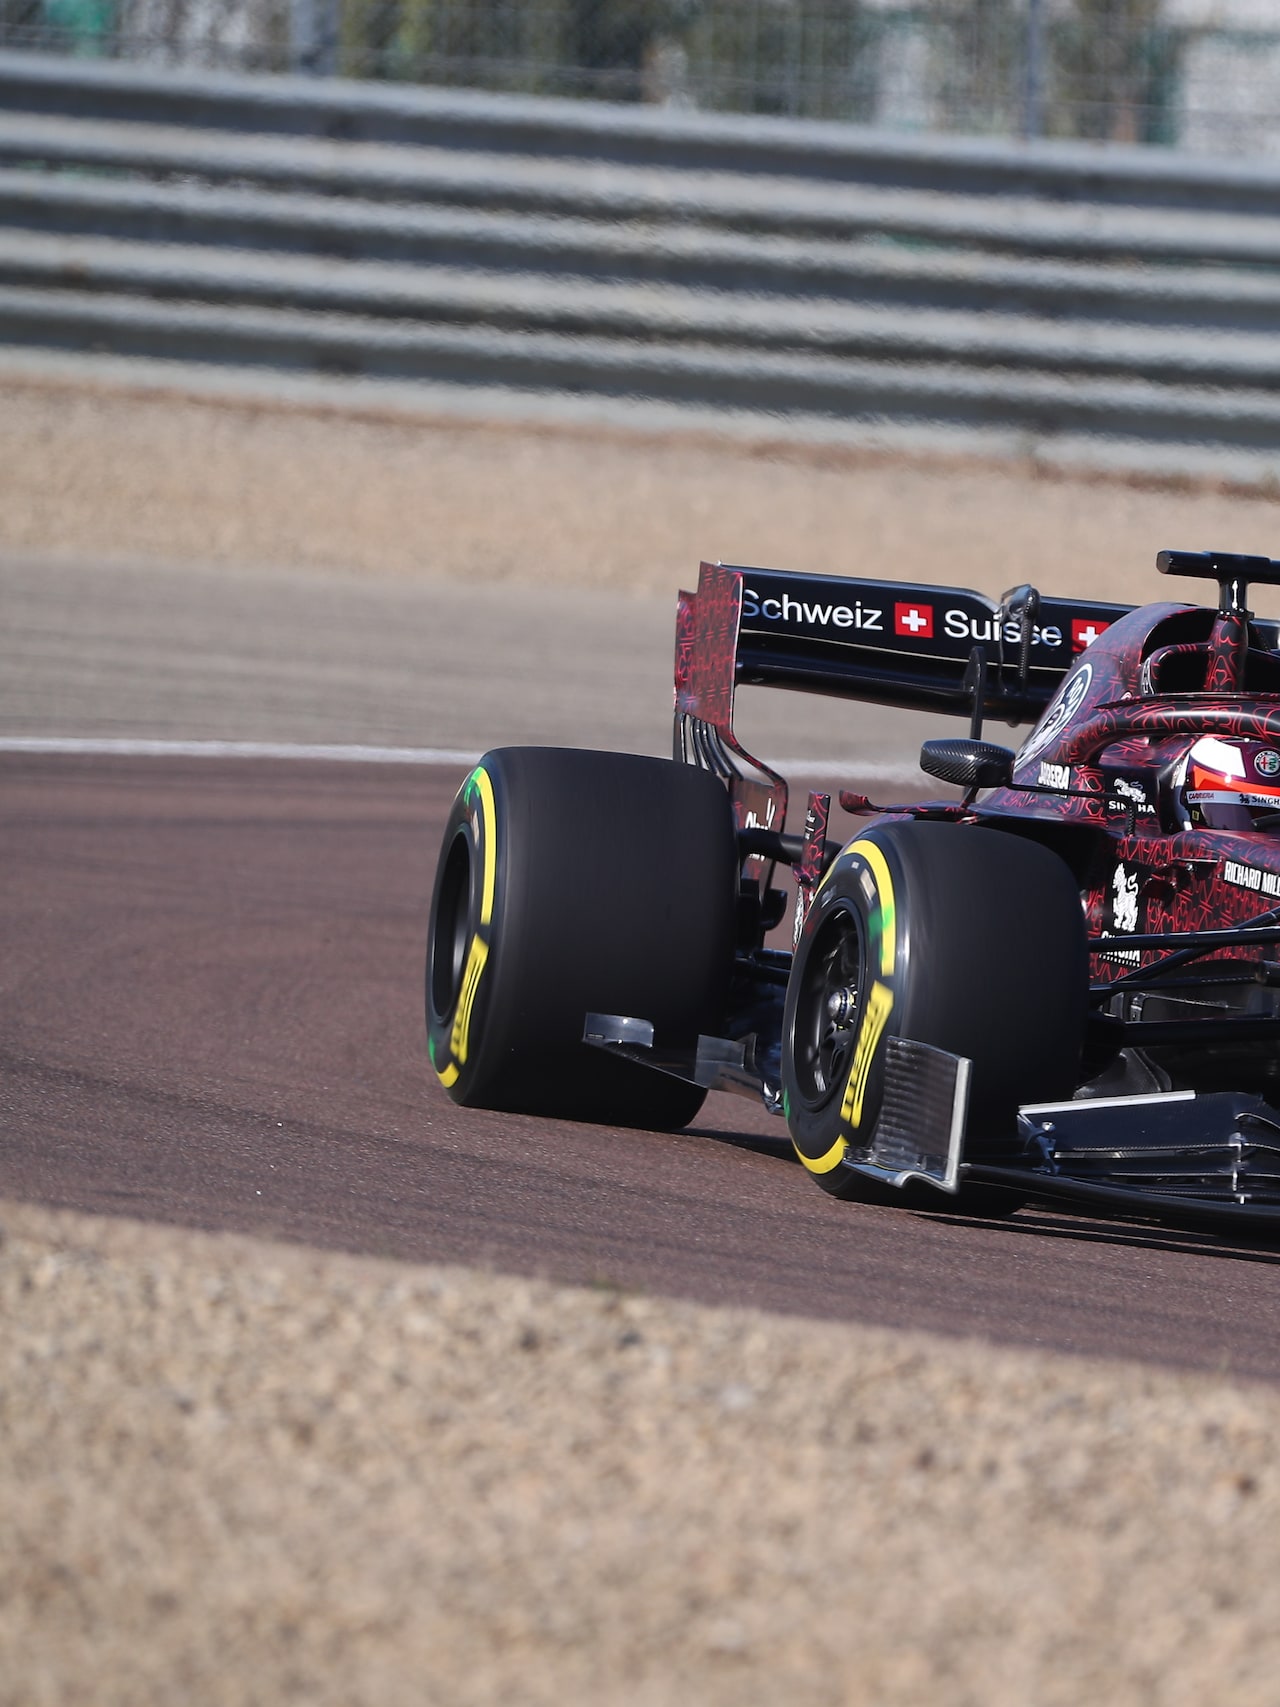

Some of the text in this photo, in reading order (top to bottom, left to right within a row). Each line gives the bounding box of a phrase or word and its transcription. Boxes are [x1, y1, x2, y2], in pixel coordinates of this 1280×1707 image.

[743, 588, 884, 631] Schweiz
[1108, 800, 1157, 814] SINHA
[1223, 860, 1262, 891] RICHARD
